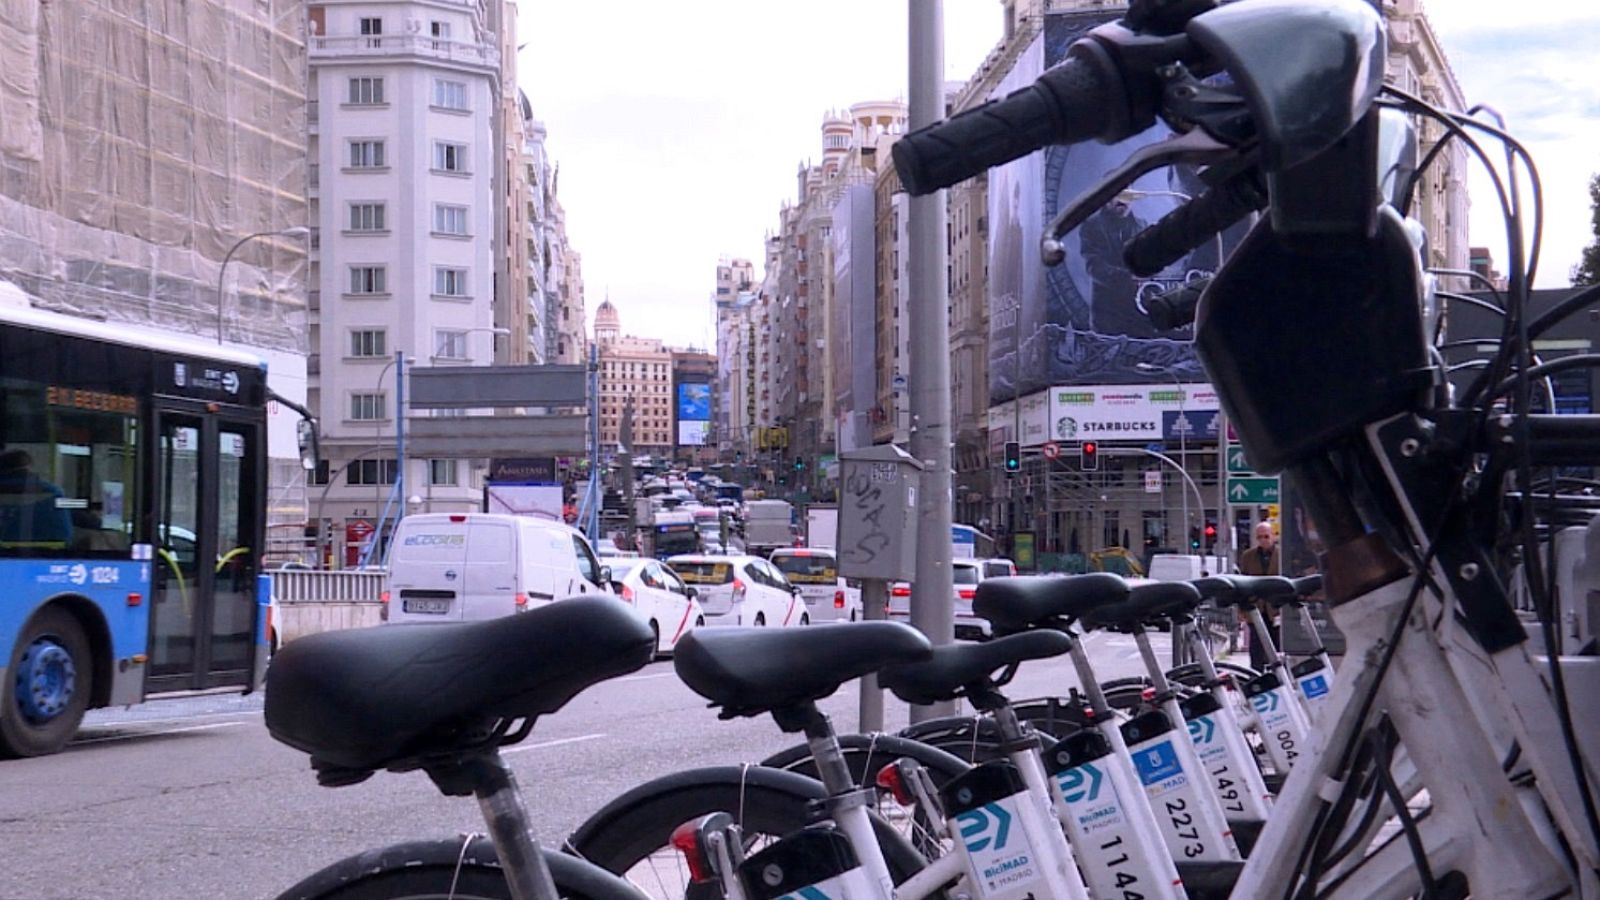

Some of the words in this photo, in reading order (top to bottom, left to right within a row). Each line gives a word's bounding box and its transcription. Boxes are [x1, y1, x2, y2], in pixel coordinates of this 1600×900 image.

[1082, 421, 1156, 432] STARBUCKS
[1277, 730, 1299, 769] 004
[1212, 765, 1244, 812] 1497
[1165, 798, 1204, 858] 2273
[983, 855, 1029, 878] BiciMAD
[998, 868, 1034, 887] MADRID
